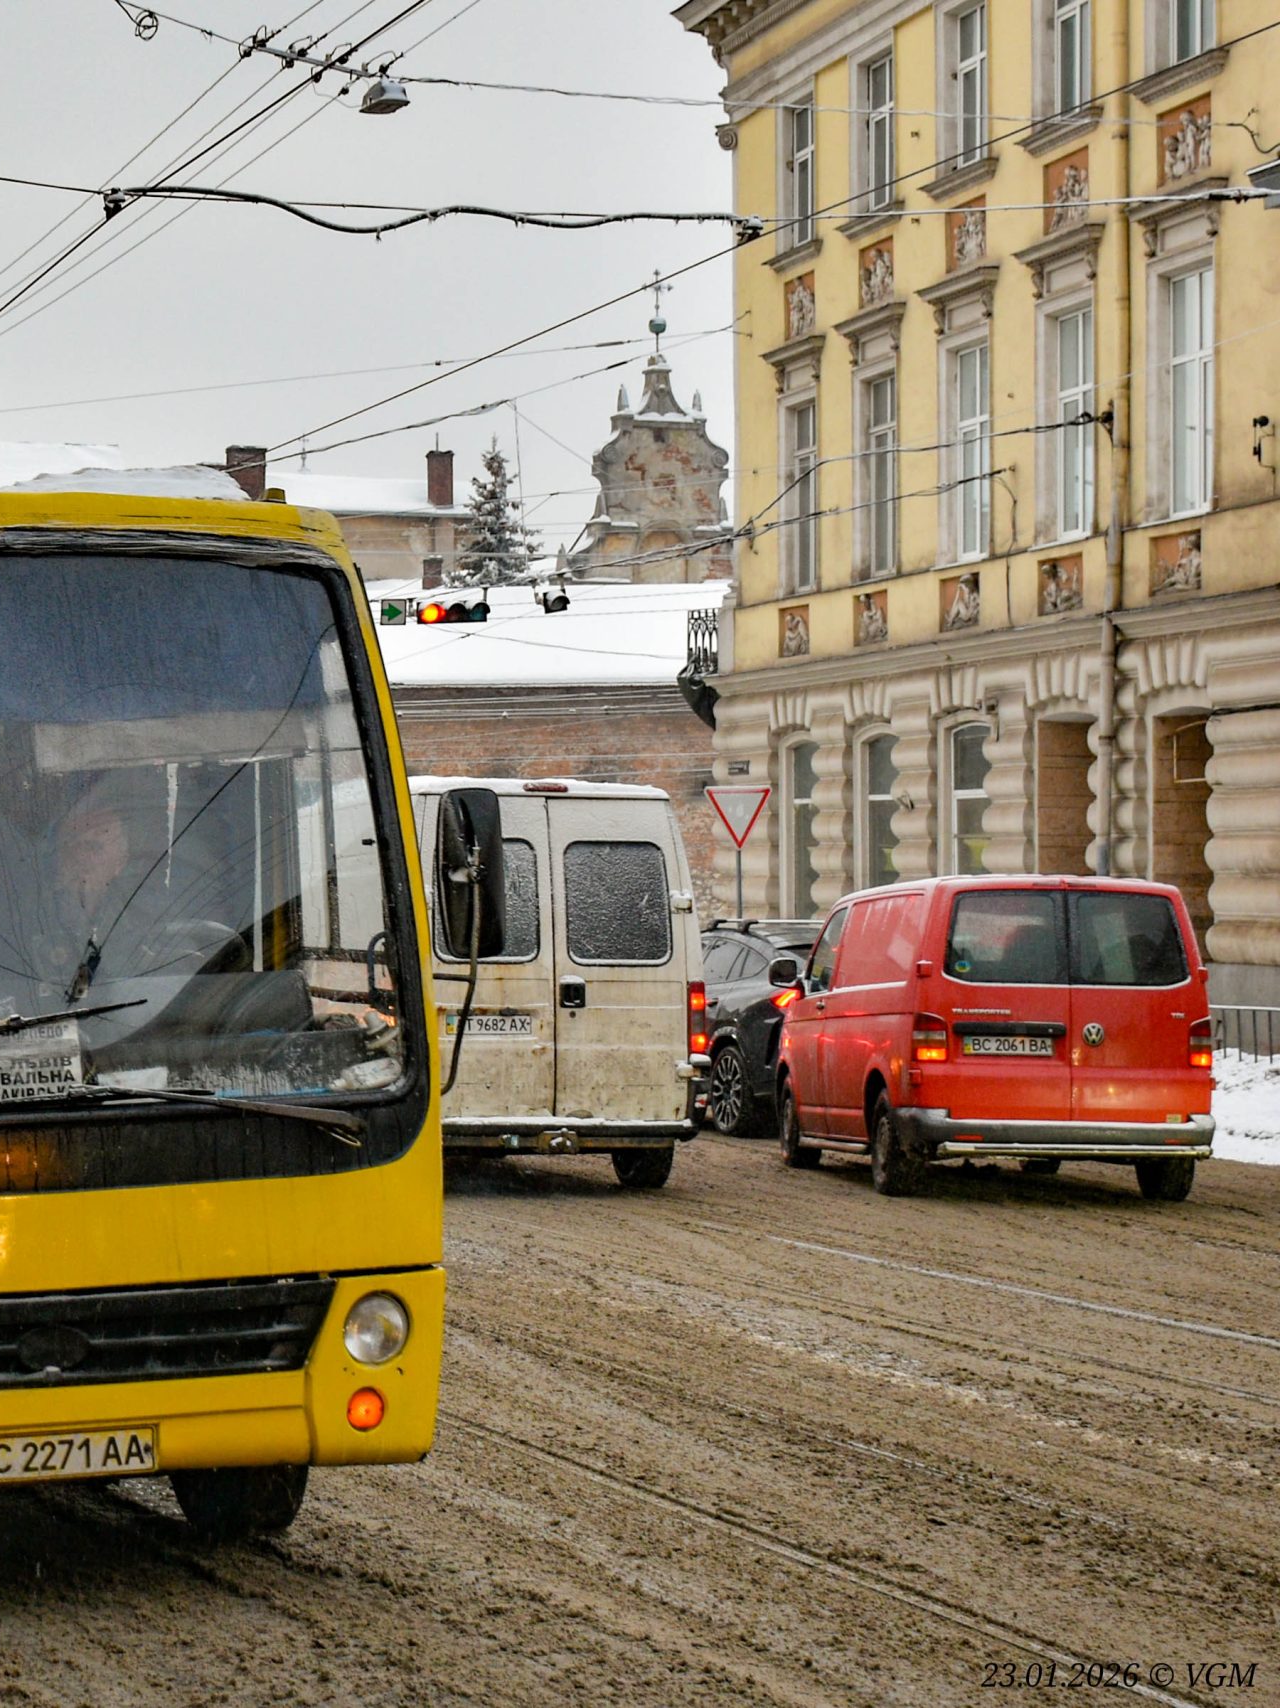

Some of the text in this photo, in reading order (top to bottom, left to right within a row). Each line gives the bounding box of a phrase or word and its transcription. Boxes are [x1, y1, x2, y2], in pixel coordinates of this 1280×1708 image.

[476, 1018, 506, 1031] 9682
[509, 1018, 528, 1031] AX
[972, 1038, 1049, 1053] BC 2061 BA
[10, 1056, 72, 1070] ЛЬВІВ
[23, 1437, 91, 1473] 2271
[102, 1434, 146, 1467] AA
